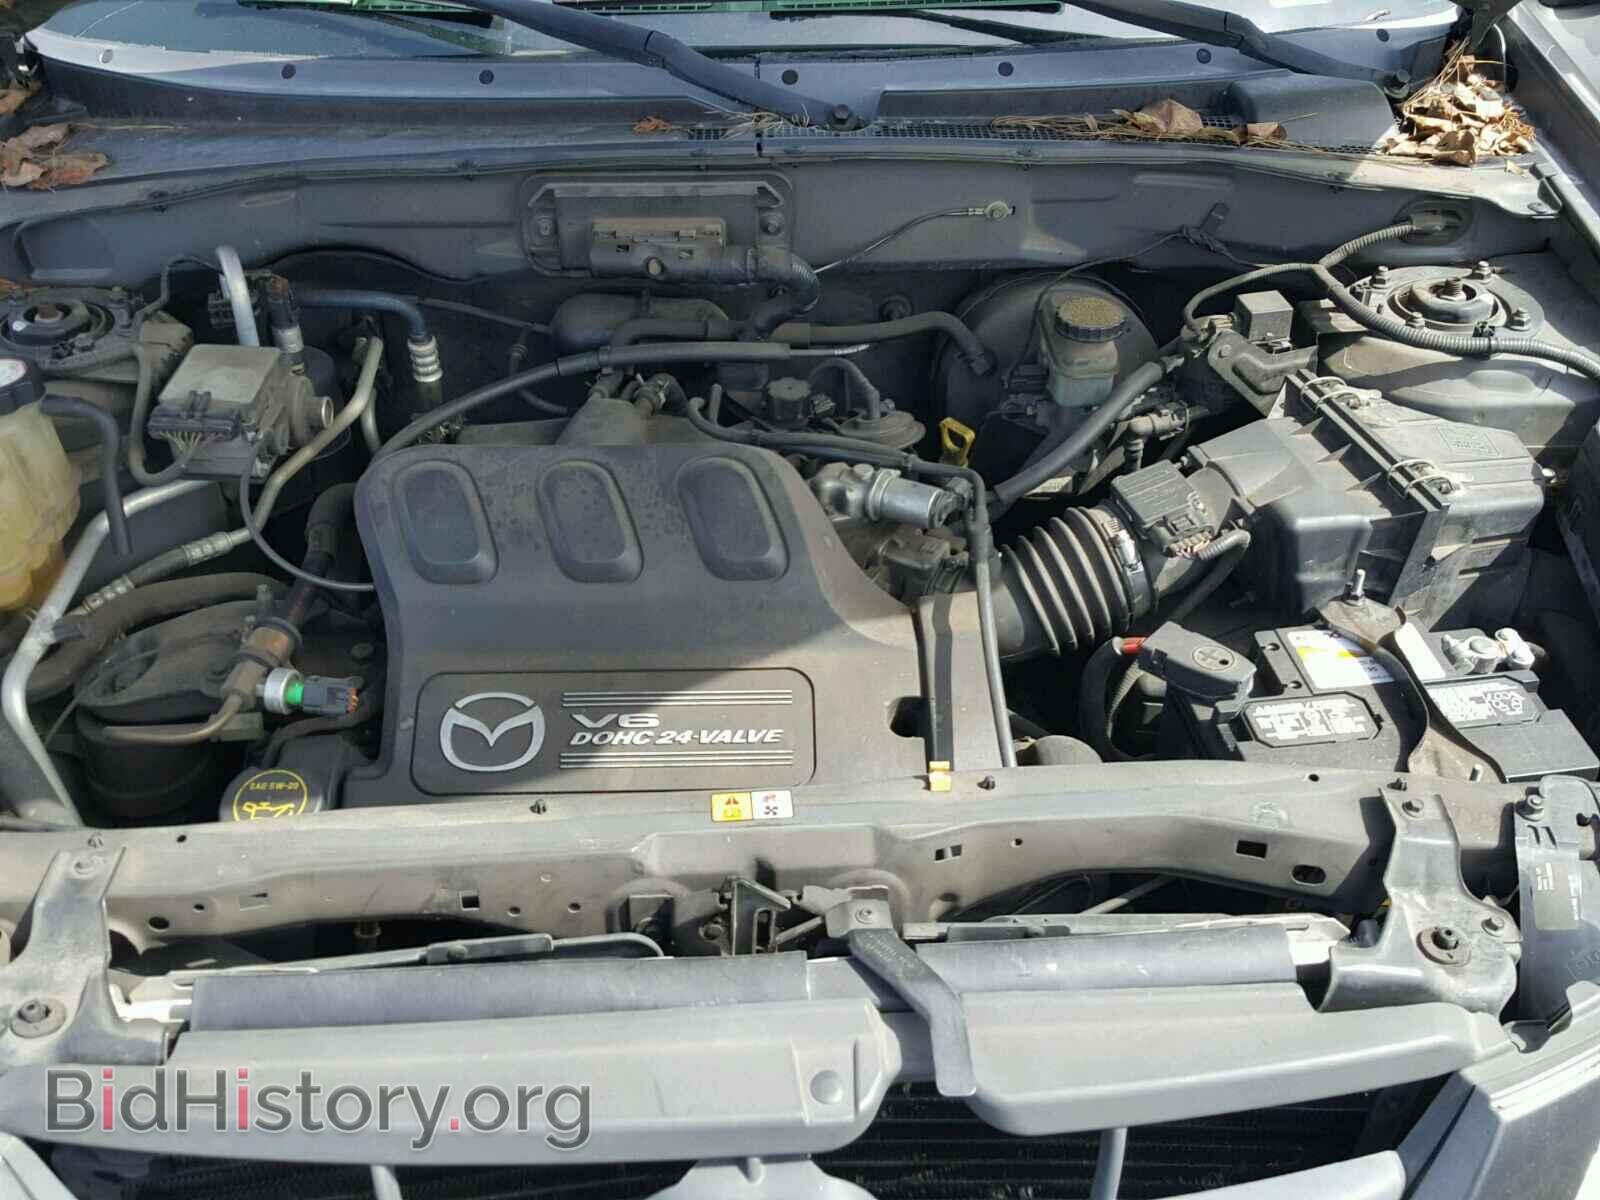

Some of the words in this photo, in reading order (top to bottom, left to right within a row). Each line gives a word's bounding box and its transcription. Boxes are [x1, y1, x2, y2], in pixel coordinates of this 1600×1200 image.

[571, 713, 661, 728] V6
[569, 729, 655, 746] DOHC
[655, 728, 784, 745] 24-VALVE
